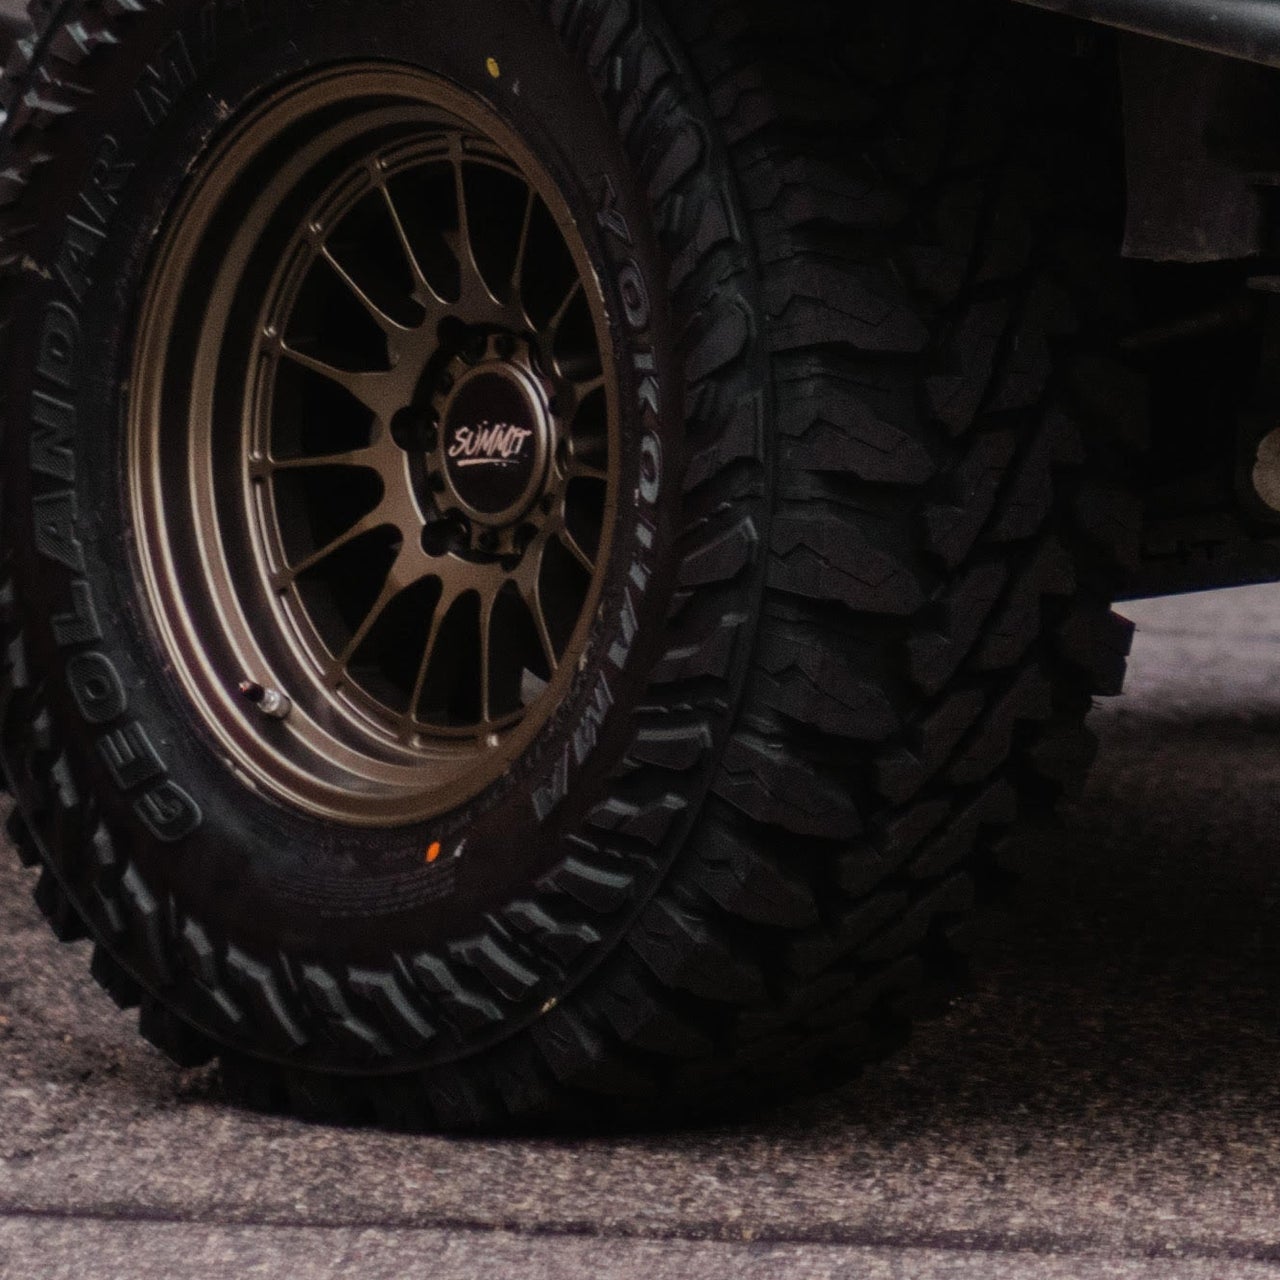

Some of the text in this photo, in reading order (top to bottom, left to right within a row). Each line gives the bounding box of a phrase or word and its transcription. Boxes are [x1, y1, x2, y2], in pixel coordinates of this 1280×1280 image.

[30, 133, 201, 840] GEOLANDAR
[448, 422, 533, 459] SUMMIT
[531, 173, 662, 823] YOKOHAMA
